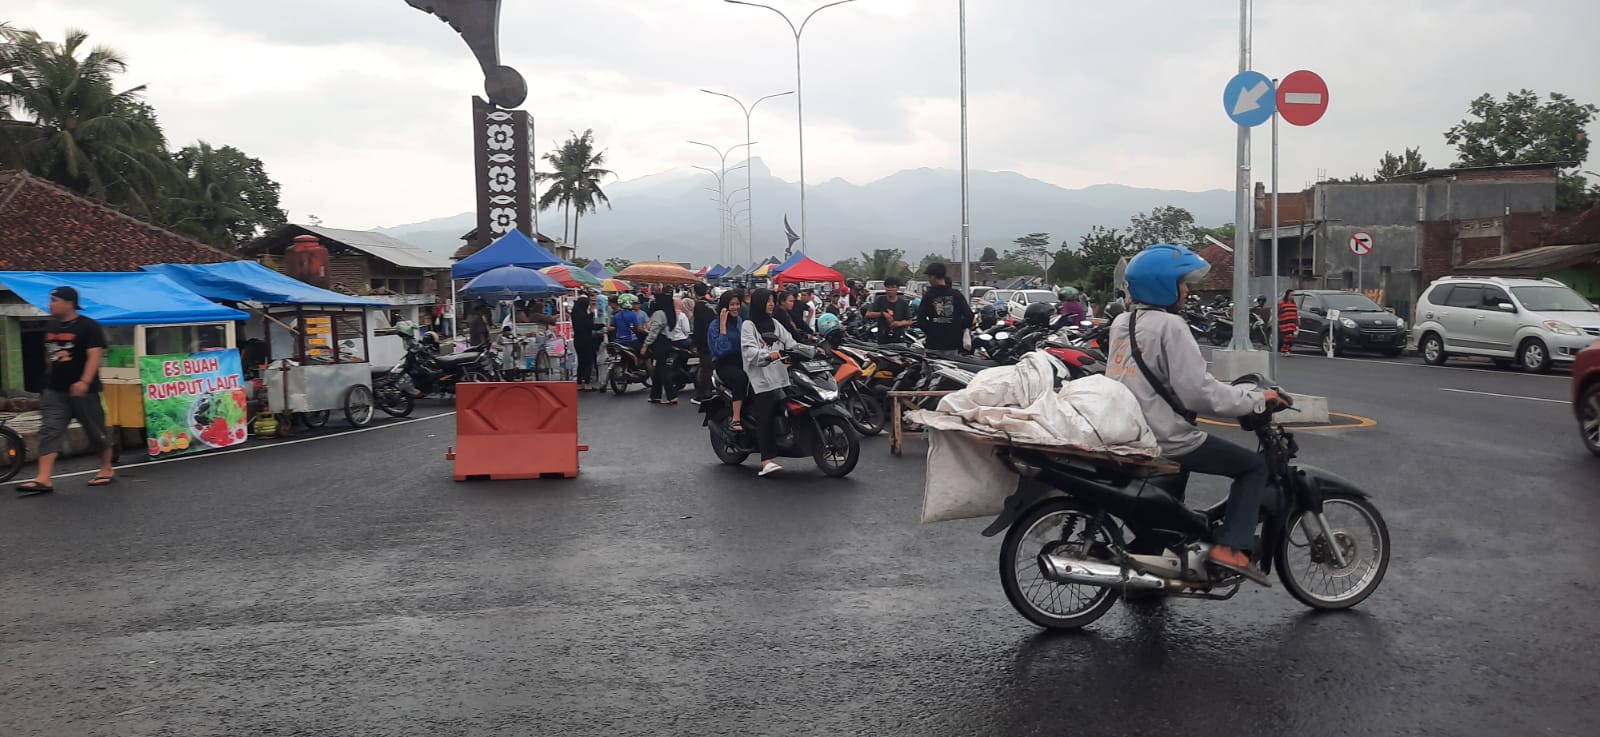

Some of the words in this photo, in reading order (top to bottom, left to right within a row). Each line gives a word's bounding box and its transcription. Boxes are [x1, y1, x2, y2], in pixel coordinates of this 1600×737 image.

[163, 360, 181, 377] ES
[183, 357, 219, 375] BUAH
[147, 378, 204, 400] RUMPUT
[207, 374, 240, 393] LAUT
